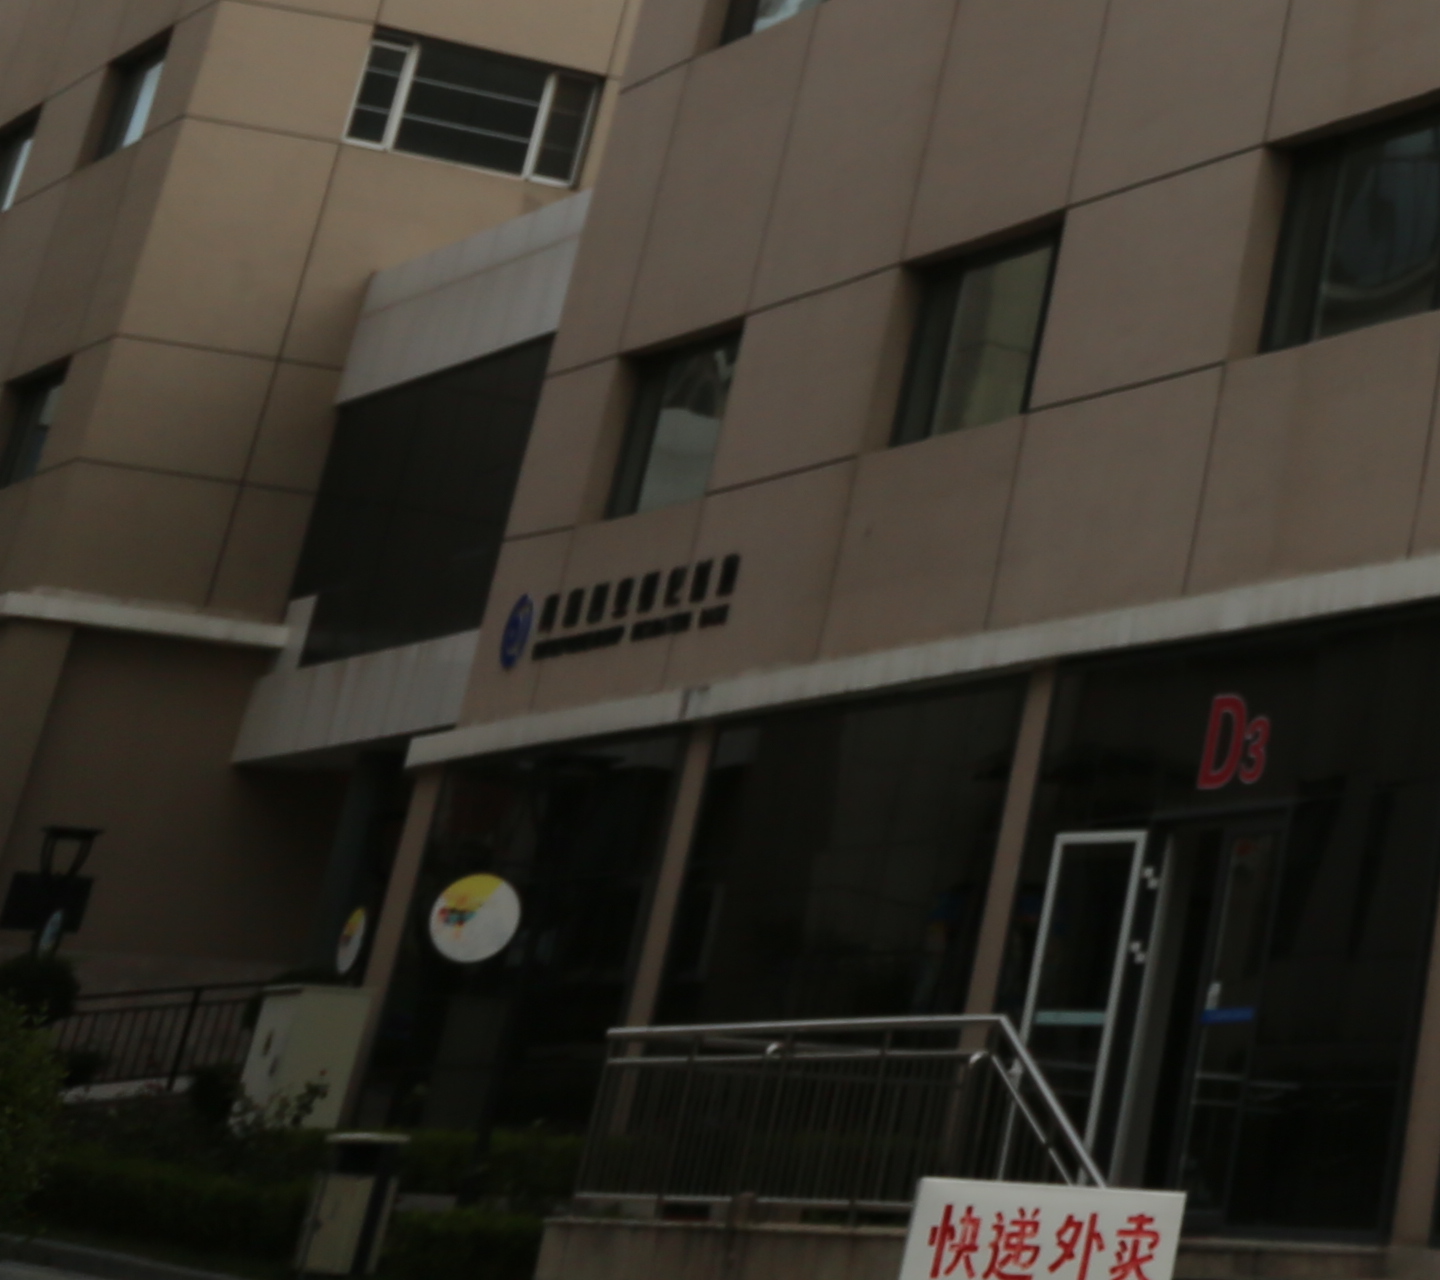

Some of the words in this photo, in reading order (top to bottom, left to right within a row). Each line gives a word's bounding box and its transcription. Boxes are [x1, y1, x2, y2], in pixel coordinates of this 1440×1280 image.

[1197, 693, 1271, 790] D3
[928, 1204, 1161, 1280] 快递外卖
